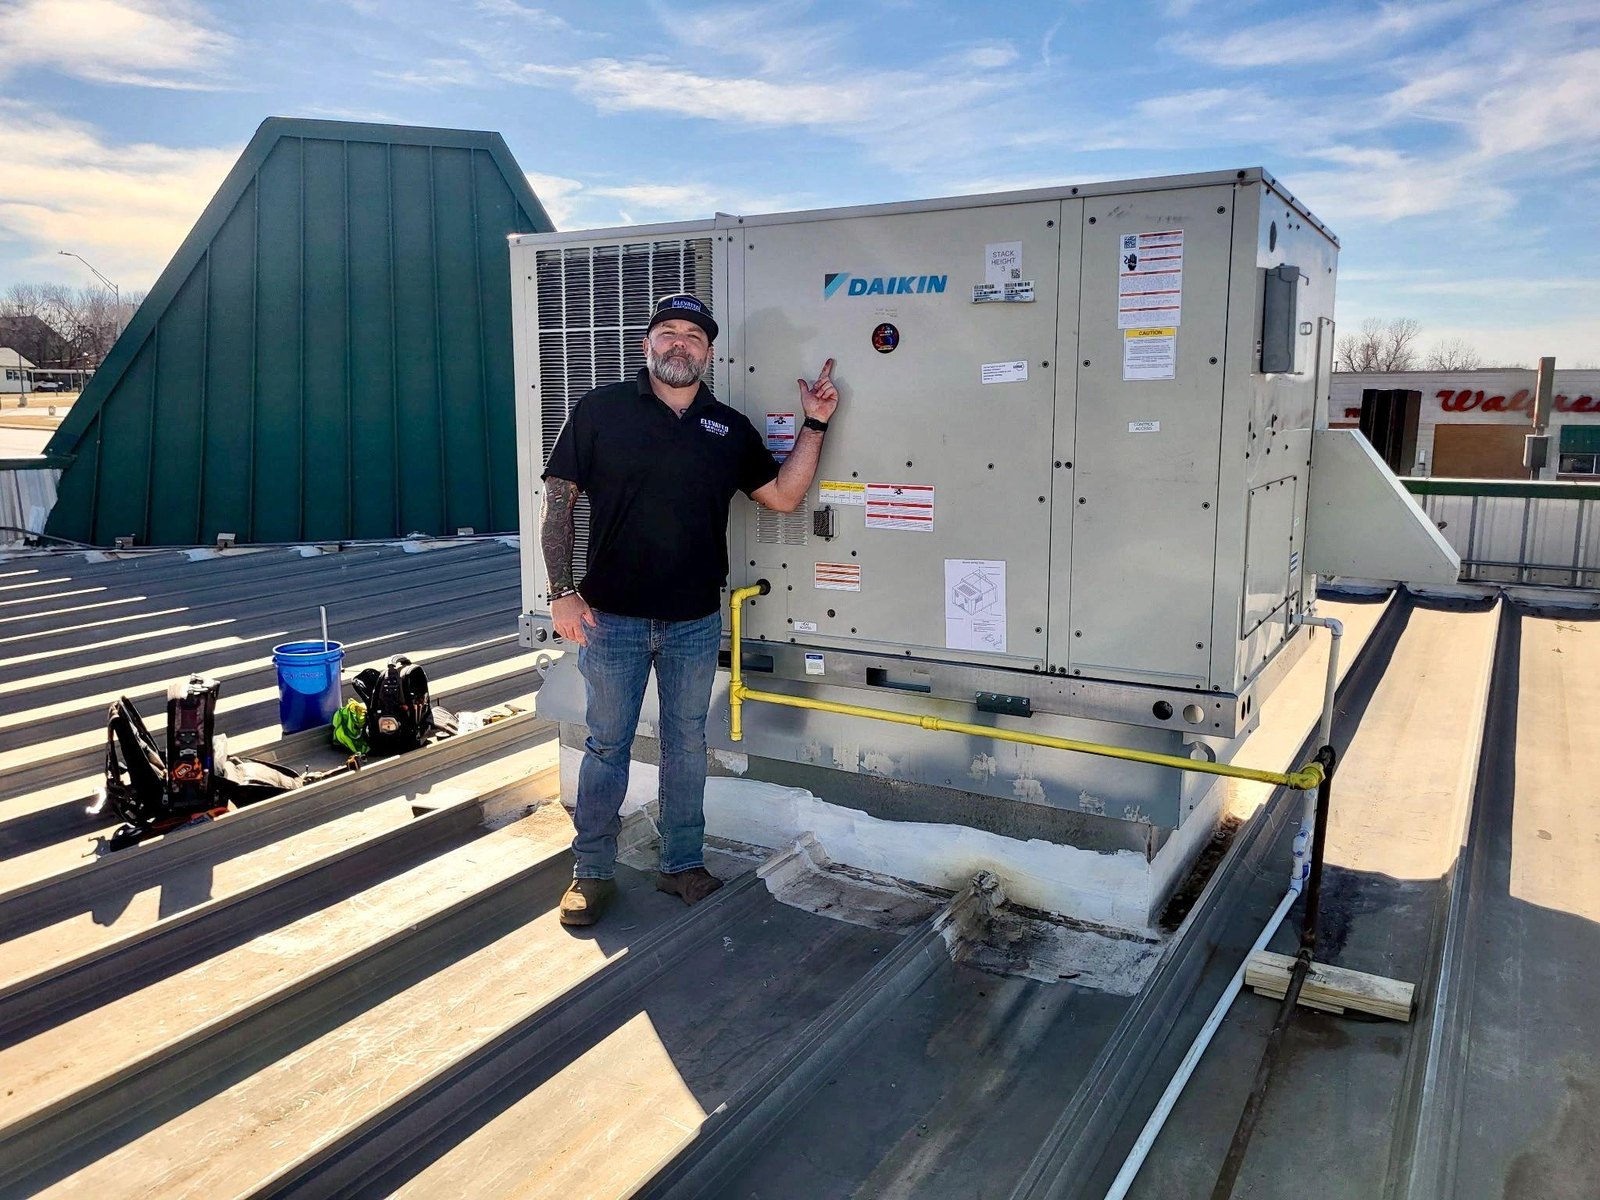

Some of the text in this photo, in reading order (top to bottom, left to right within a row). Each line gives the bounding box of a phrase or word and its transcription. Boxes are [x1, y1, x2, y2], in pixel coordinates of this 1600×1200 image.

[991, 257, 1016, 265] HEIGHT
[992, 250, 1015, 258] STACK
[848, 275, 948, 296] DAIKIN
[1435, 389, 1600, 418] Walre
[700, 418, 729, 433] ELEVATED
